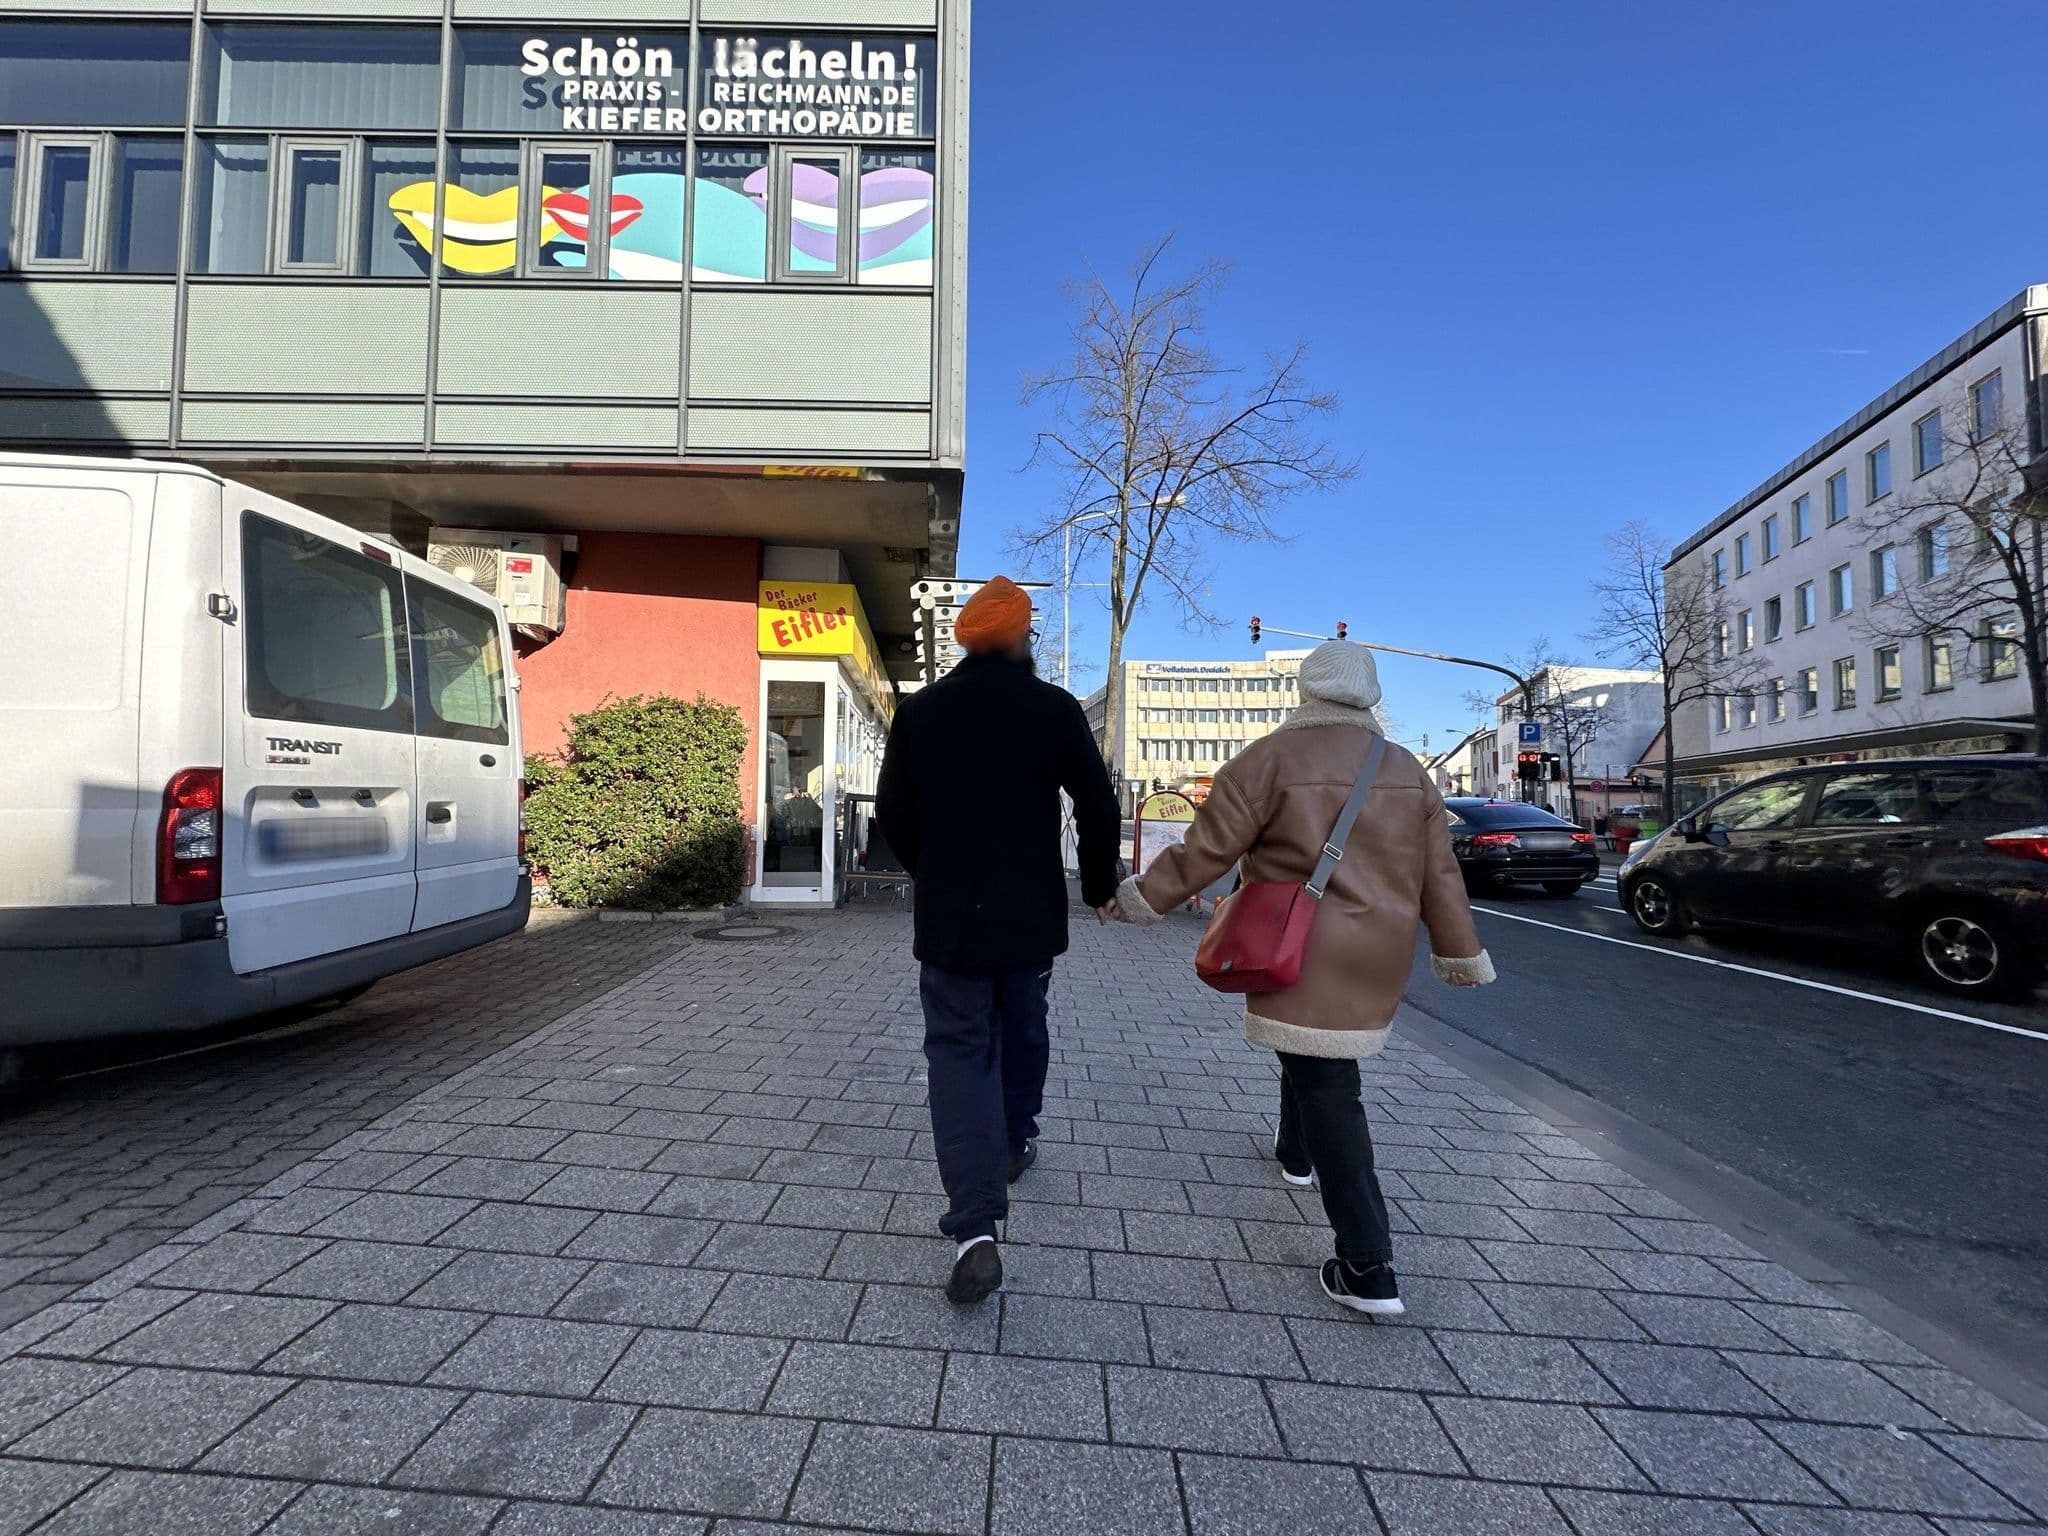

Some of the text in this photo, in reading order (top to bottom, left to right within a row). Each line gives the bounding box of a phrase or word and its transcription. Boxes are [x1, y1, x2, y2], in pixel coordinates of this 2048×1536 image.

[520, 37, 917, 82] Schön lächeln!
[713, 81, 916, 106] REICHMANN.DE
[562, 104, 915, 136] KIEFER ORTHOPÄDIE
[765, 588, 785, 602] Der
[777, 591, 817, 611] Bäcker
[771, 606, 847, 648] Eifler
[1523, 725, 1536, 739] P
[266, 737, 343, 755] TRANSIT
[1159, 803, 1188, 818] Eifler
